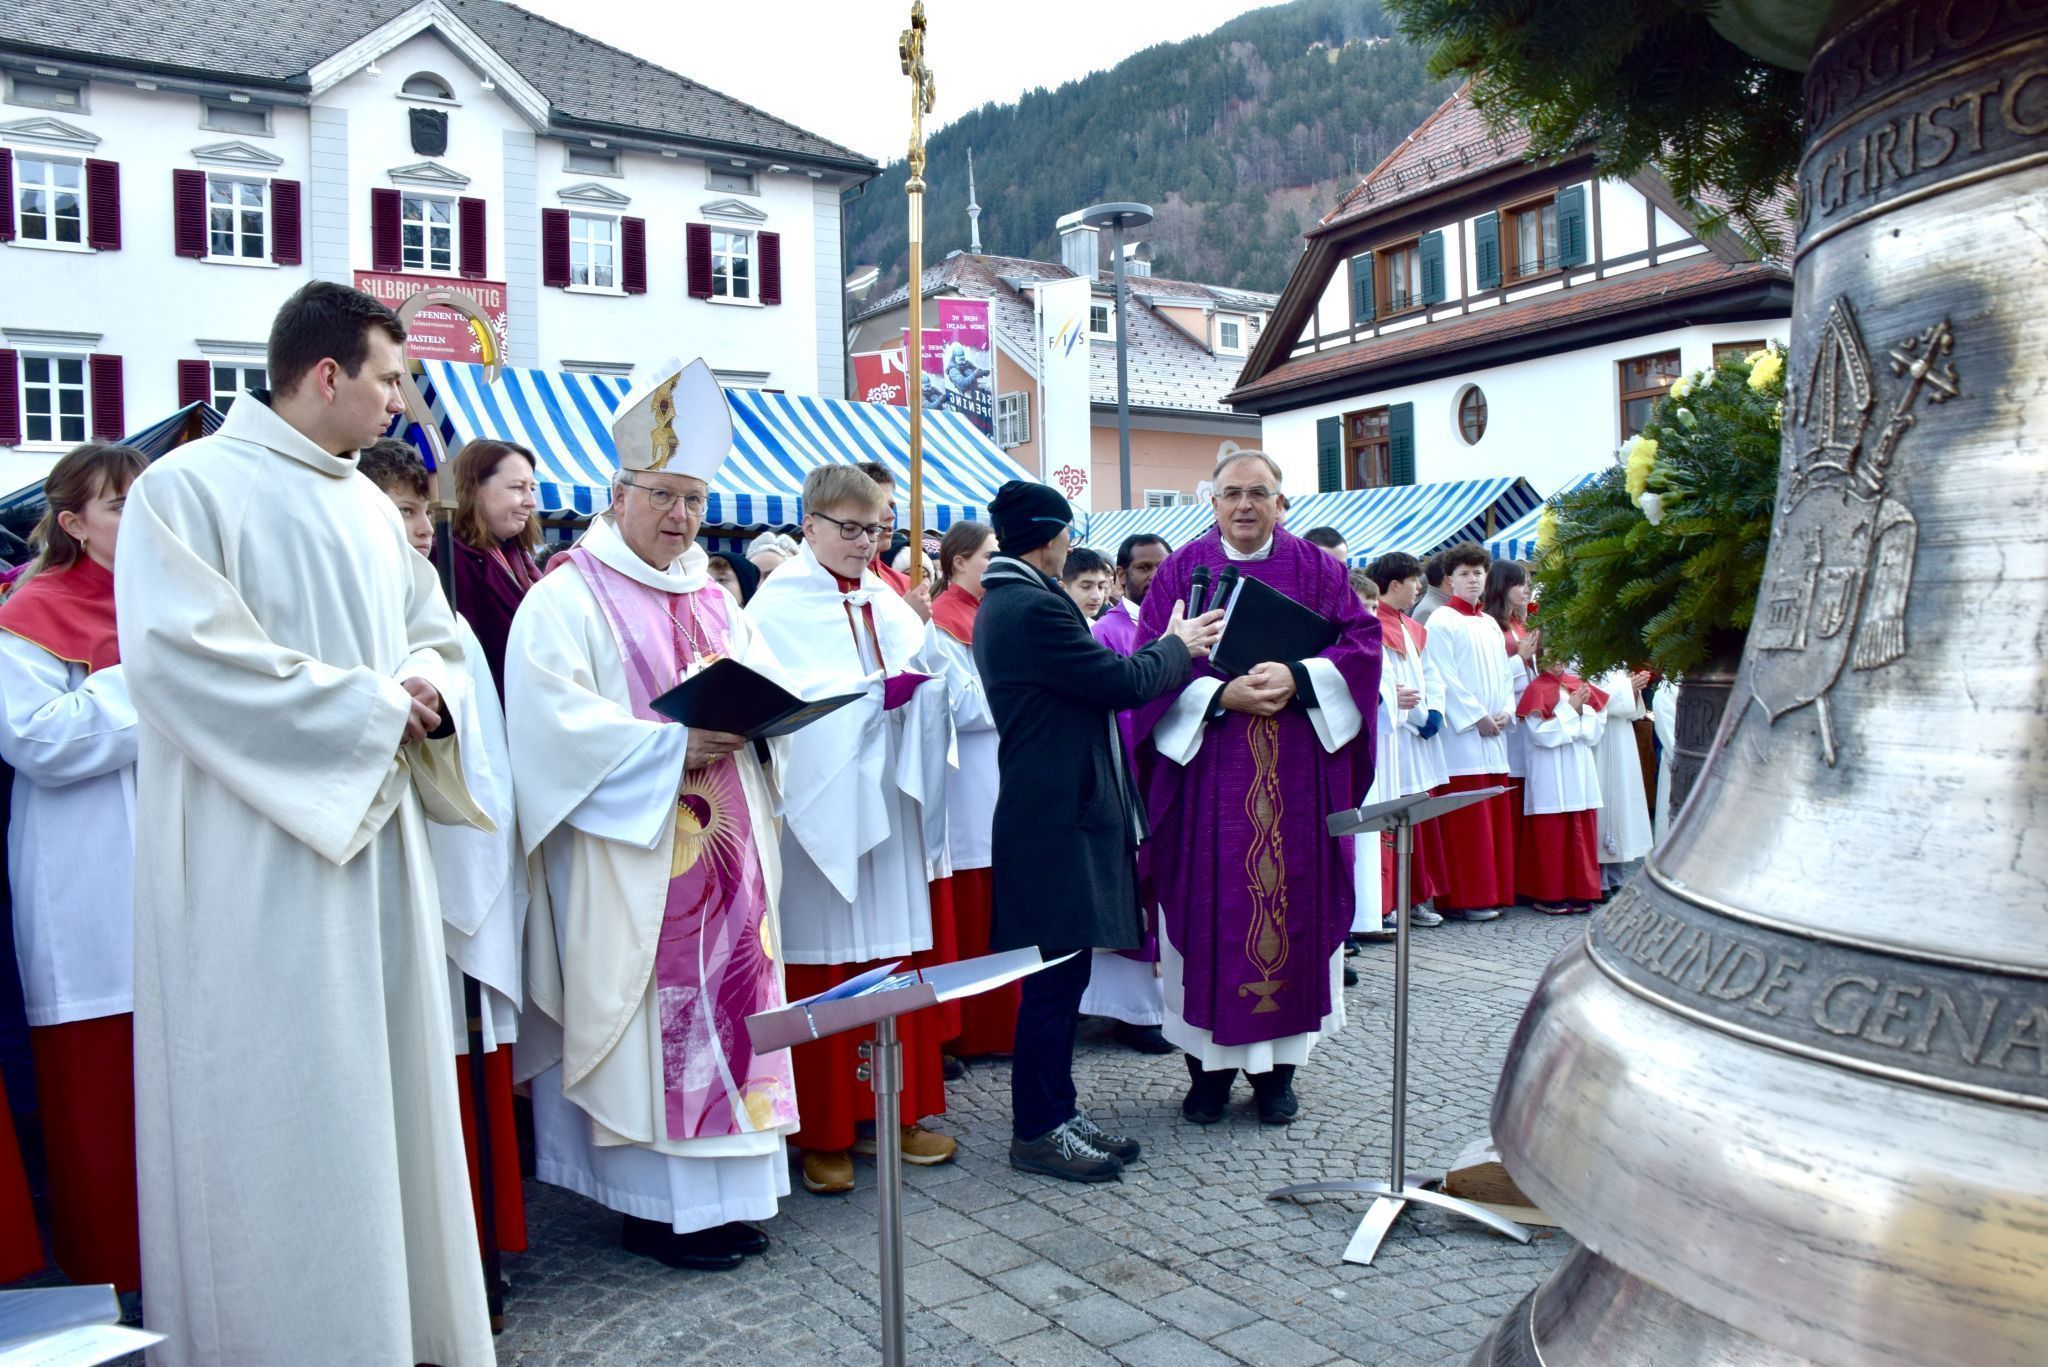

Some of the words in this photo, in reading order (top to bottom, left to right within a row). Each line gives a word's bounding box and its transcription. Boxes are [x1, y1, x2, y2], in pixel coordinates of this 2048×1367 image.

[415, 310, 452, 320] FFENEN
[407, 334, 446, 344] BASTELN
[1066, 485, 1084, 500] 27
